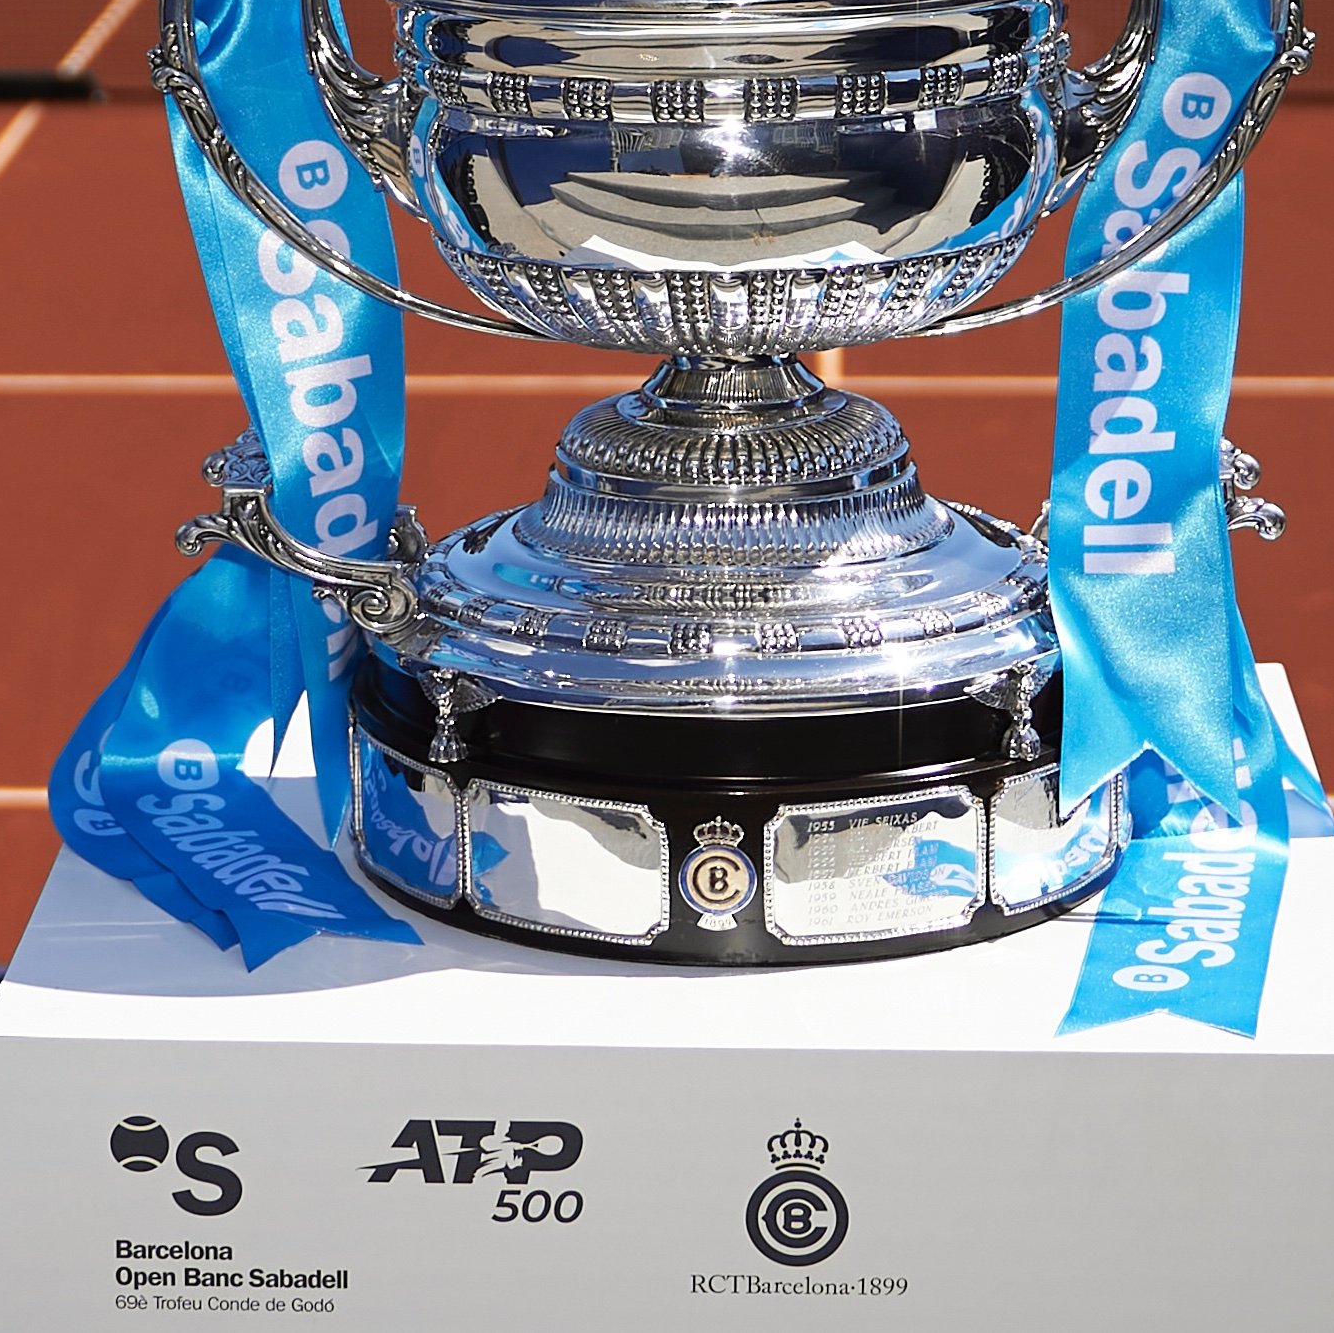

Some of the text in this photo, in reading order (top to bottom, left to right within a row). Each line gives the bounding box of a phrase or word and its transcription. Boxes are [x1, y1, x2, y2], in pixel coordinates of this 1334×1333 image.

[136, 793, 347, 919] Sabadell
[355, 1119, 584, 1185] ATP
[491, 1190, 584, 1223] 500
[115, 1239, 233, 1260] Barcelona
[115, 1266, 348, 1290] Open Banc Sabadell
[115, 1294, 335, 1313] 69è Trofeu Conde de Godó
